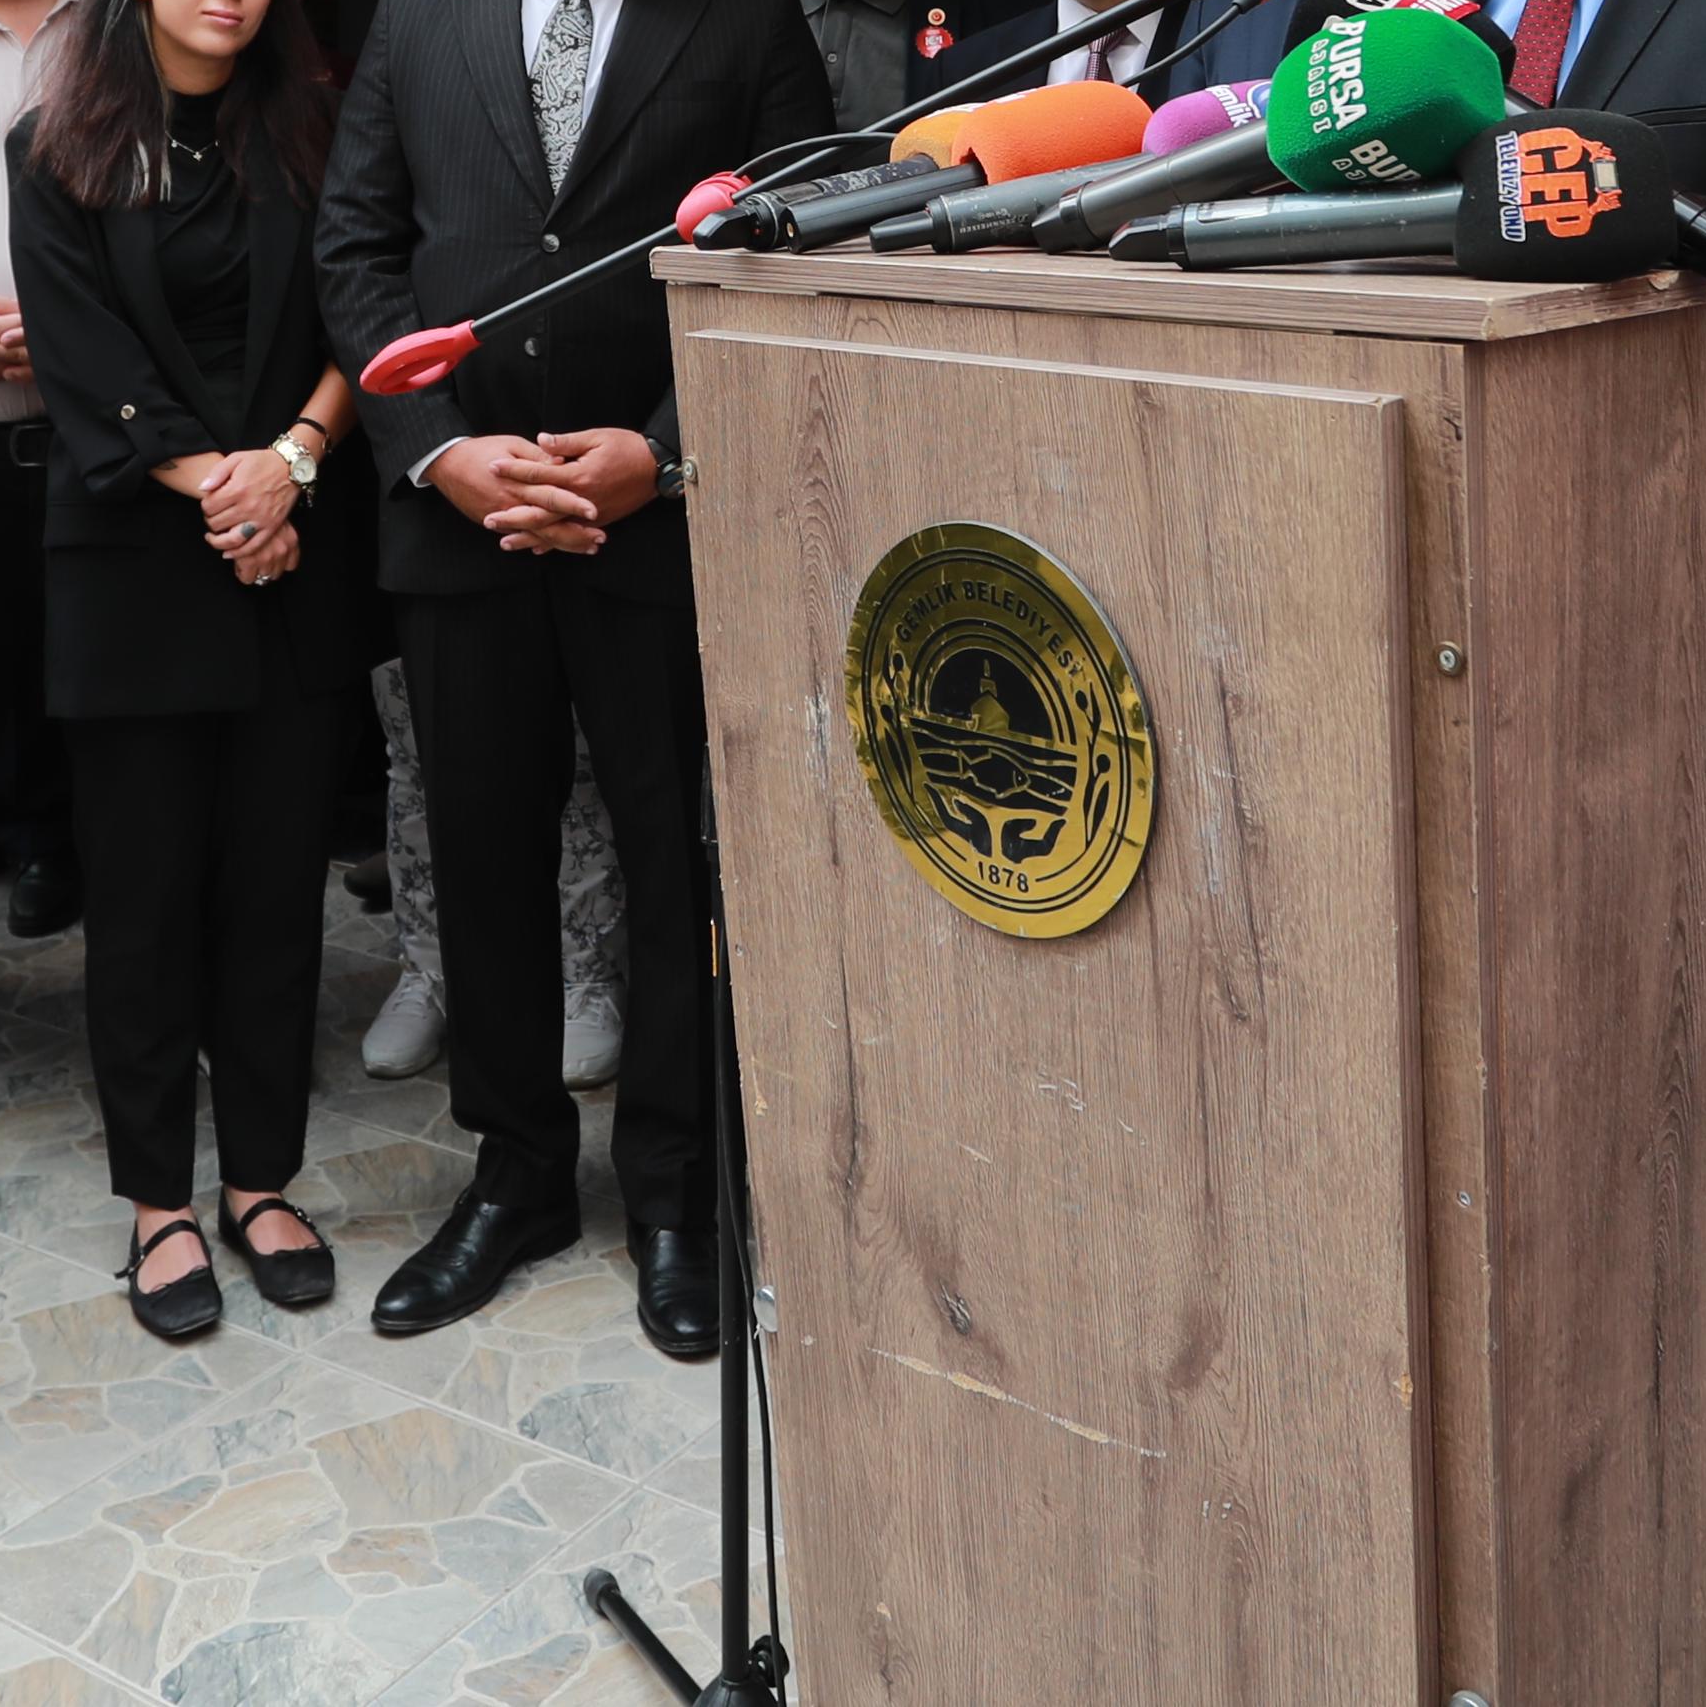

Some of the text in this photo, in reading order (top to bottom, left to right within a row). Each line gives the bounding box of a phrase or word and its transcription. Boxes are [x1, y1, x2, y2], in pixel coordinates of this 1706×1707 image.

[1306, 38, 1333, 134] AJANSI
[1327, 19, 1367, 131] BURSA
[1518, 127, 1593, 238] CEP
[895, 579, 1087, 682] GEMLİK BELEDİYESİ
[976, 860, 1030, 894] 1878
